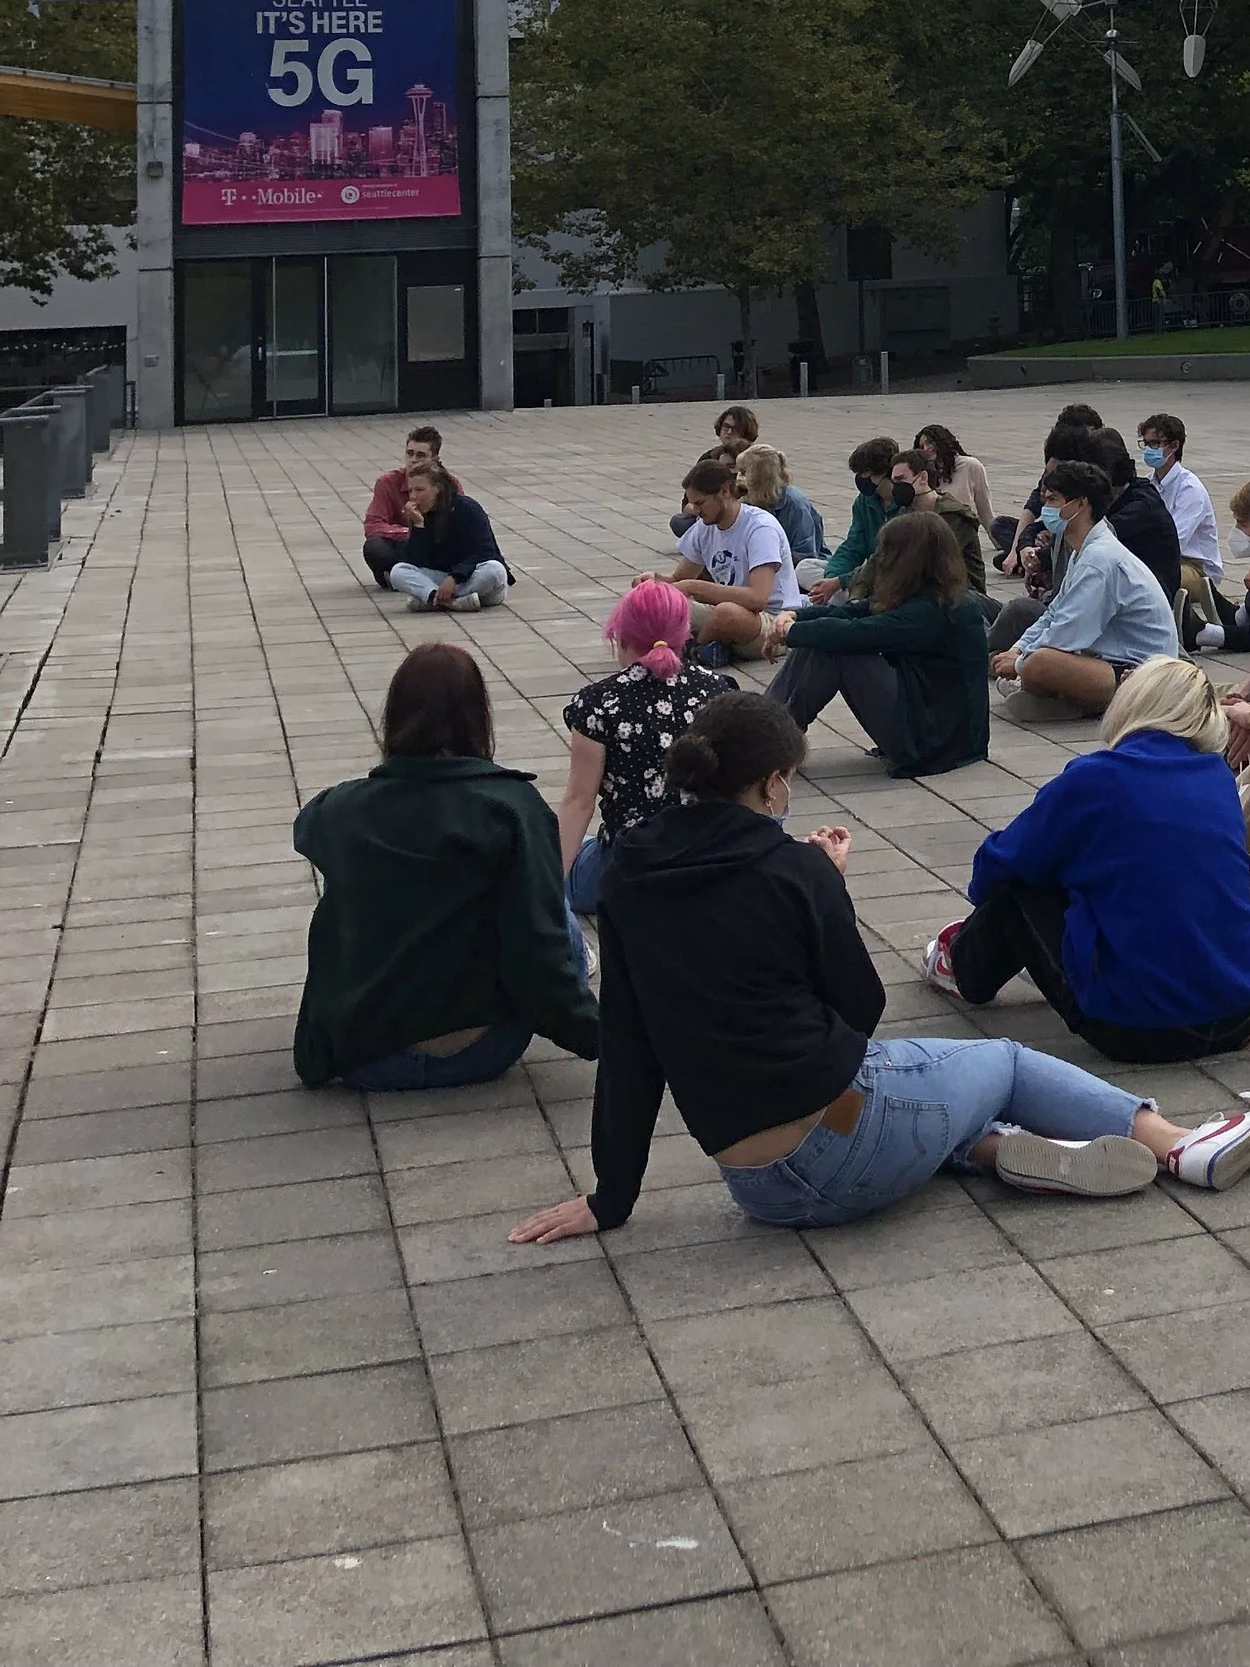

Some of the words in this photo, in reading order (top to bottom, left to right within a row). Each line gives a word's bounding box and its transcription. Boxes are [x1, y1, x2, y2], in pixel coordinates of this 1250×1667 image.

[256, 11, 306, 34] IT’S
[311, 11, 384, 34] HERE
[267, 37, 374, 107] 5G
